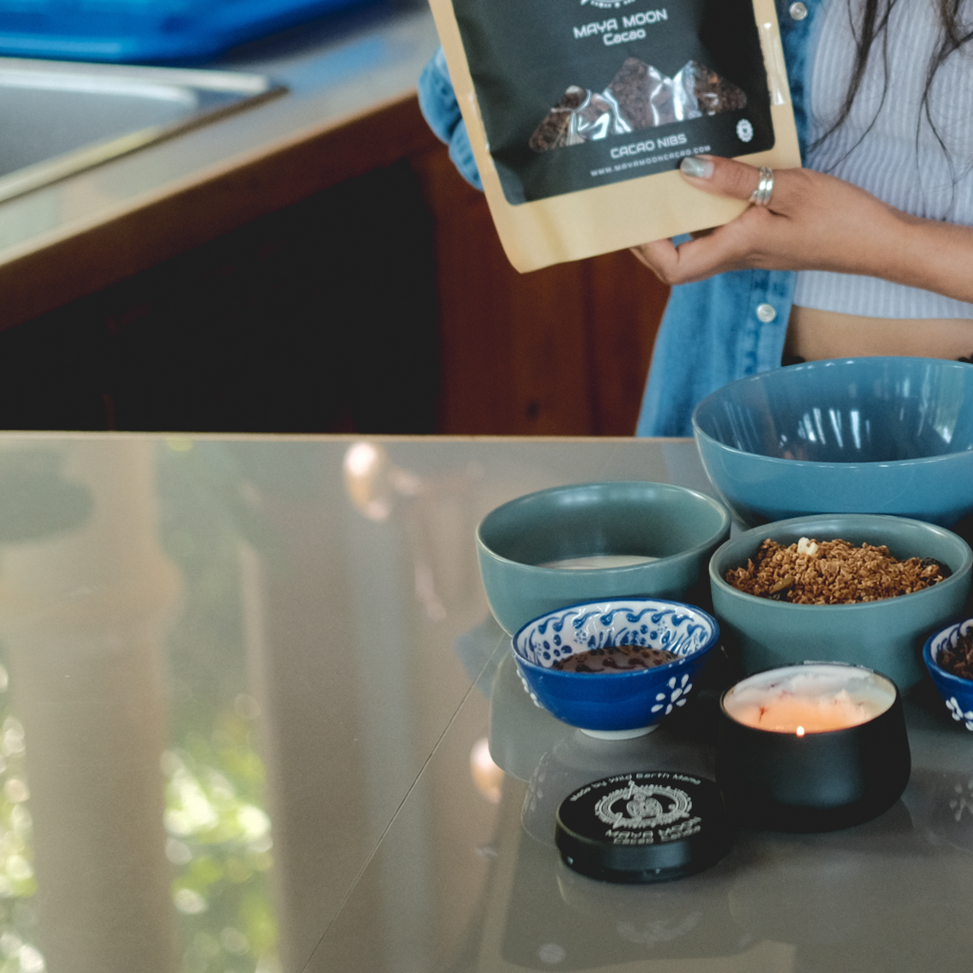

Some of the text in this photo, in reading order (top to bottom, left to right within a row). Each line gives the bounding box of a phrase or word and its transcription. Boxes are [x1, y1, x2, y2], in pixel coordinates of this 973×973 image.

[573, 8, 668, 39] MAYA MOON
[603, 28, 647, 46] Cacao
[610, 133, 688, 159] CACAO NIBS
[604, 829, 654, 840] MAYA
